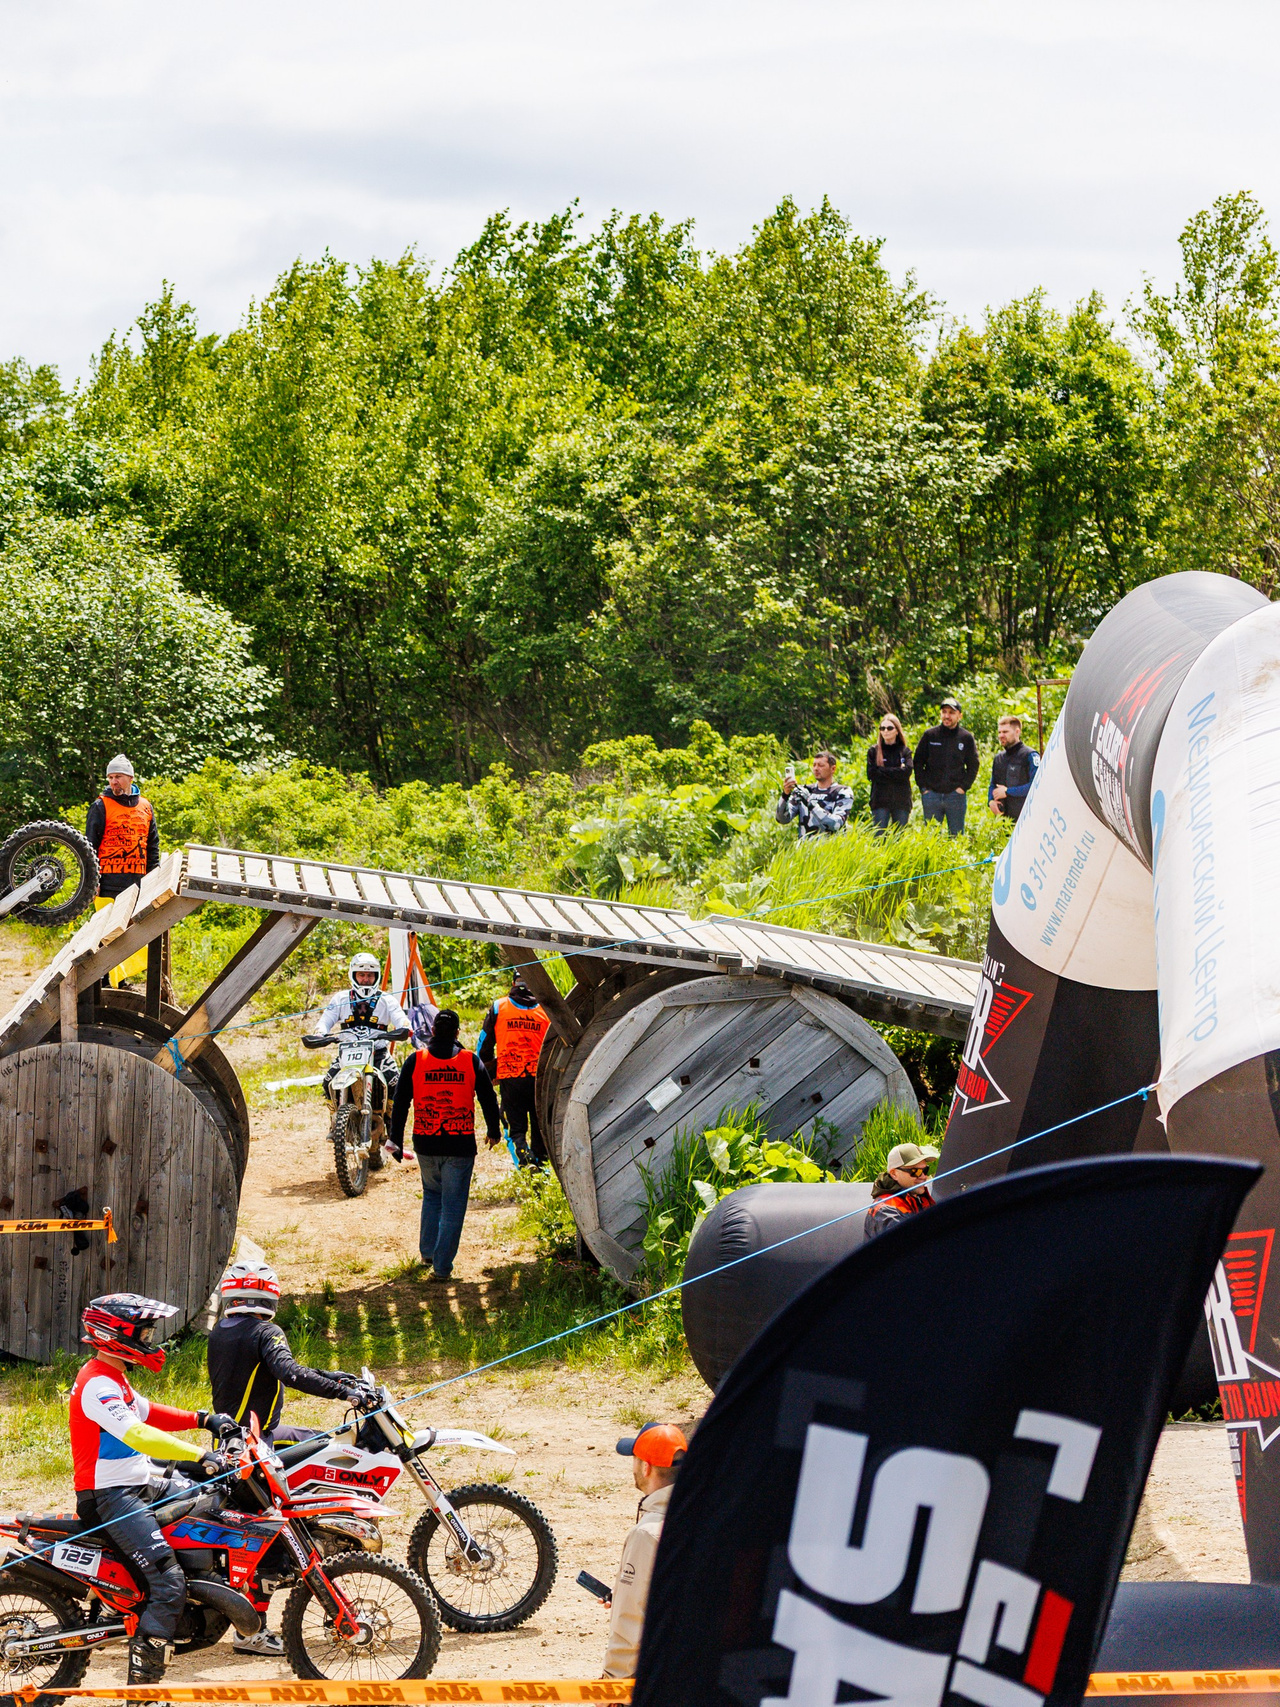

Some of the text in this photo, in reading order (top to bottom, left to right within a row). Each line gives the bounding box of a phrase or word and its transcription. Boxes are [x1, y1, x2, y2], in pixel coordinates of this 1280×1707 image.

[1028, 807, 1067, 891] 31-13-13
[1039, 829, 1097, 947] www.maremed.ru
[507, 1020, 541, 1031] МАРШАЛ
[347, 1052, 363, 1061] 110
[425, 1072, 465, 1082] МАРШАЛ
[965, 1072, 990, 1104] RUN
[16, 1221, 48, 1231] KTM
[60, 1221, 94, 1230] KTM
[170, 1521, 266, 1553] KTM
[61, 1548, 96, 1566] 125
[32, 1642, 56, 1651] X-GRIP
